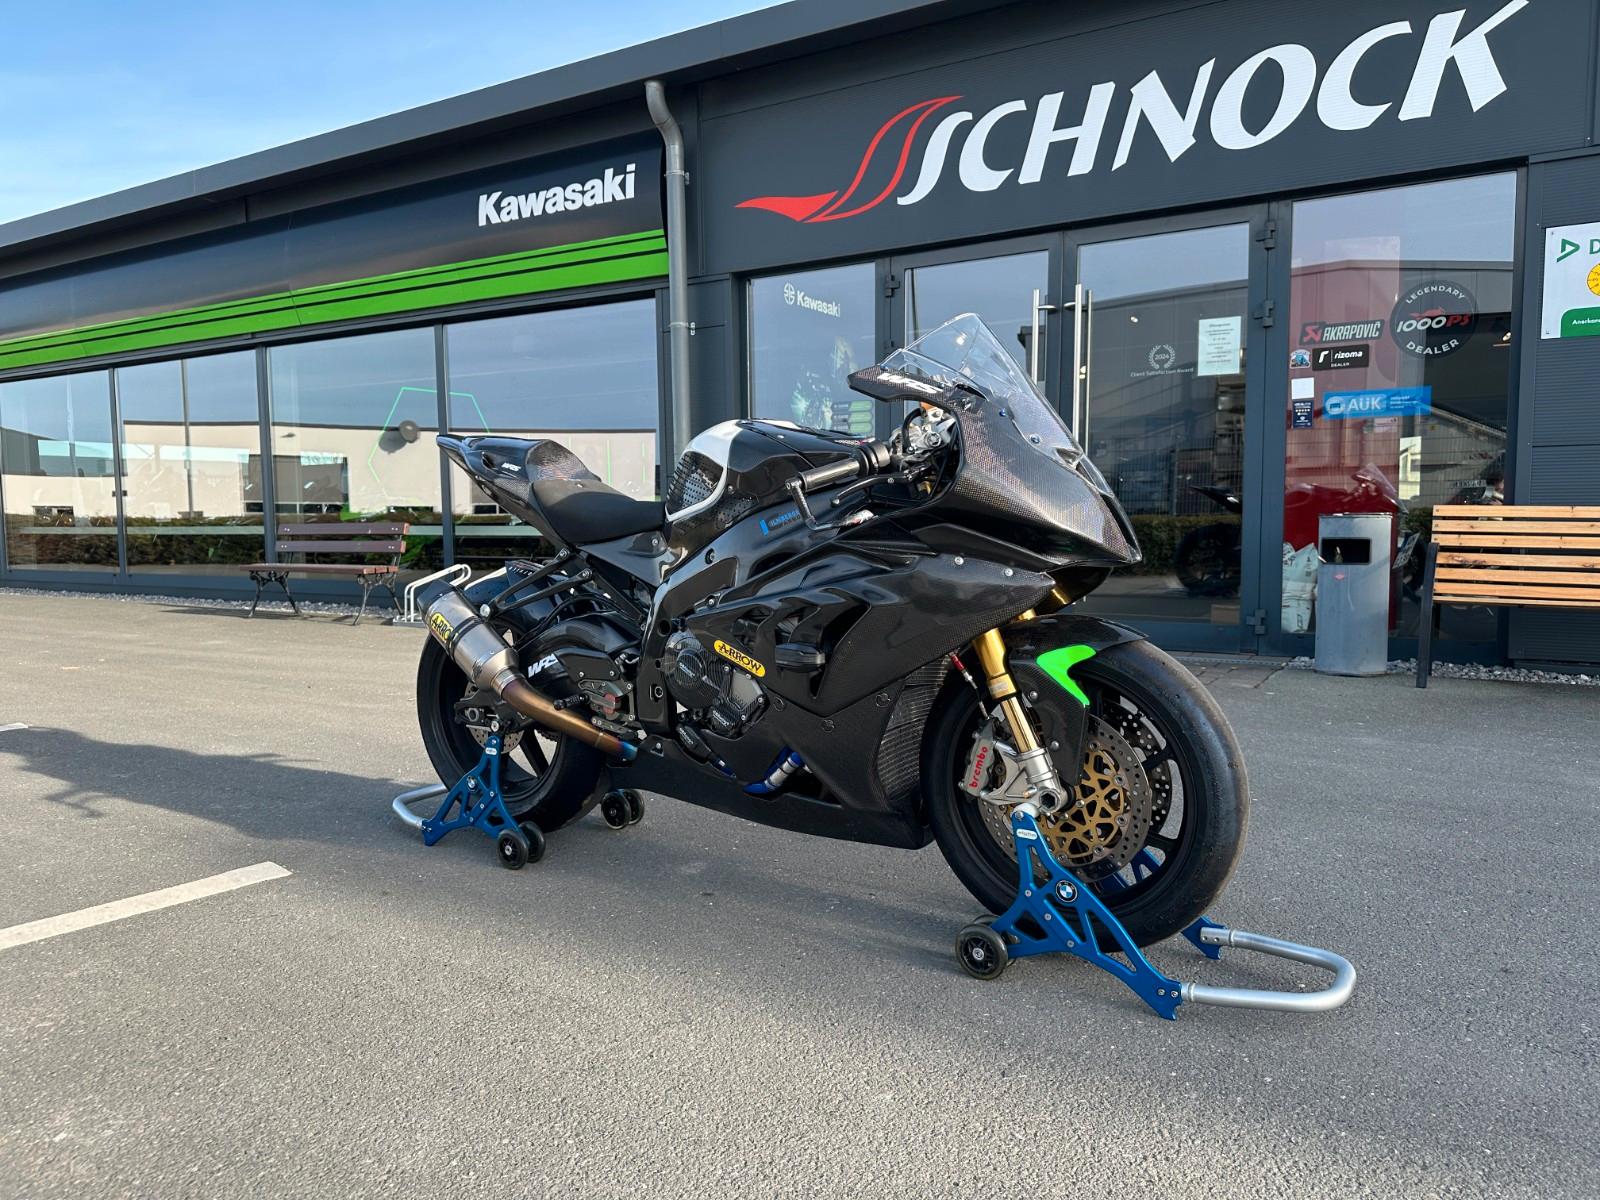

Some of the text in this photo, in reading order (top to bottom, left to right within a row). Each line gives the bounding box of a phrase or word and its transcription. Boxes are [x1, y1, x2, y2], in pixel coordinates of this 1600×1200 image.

[897, 0, 1529, 205] SCHNOCK
[478, 163, 636, 227] Kawasaki
[796, 290, 841, 318] Kawasaki
[1405, 285, 1466, 304] LEGENDARY
[1396, 314, 1472, 333] 1000PS
[1334, 350, 1363, 359] rizoma
[1406, 338, 1459, 355] DEALER
[719, 643, 762, 672] ARROW
[968, 746, 988, 787] brembo
